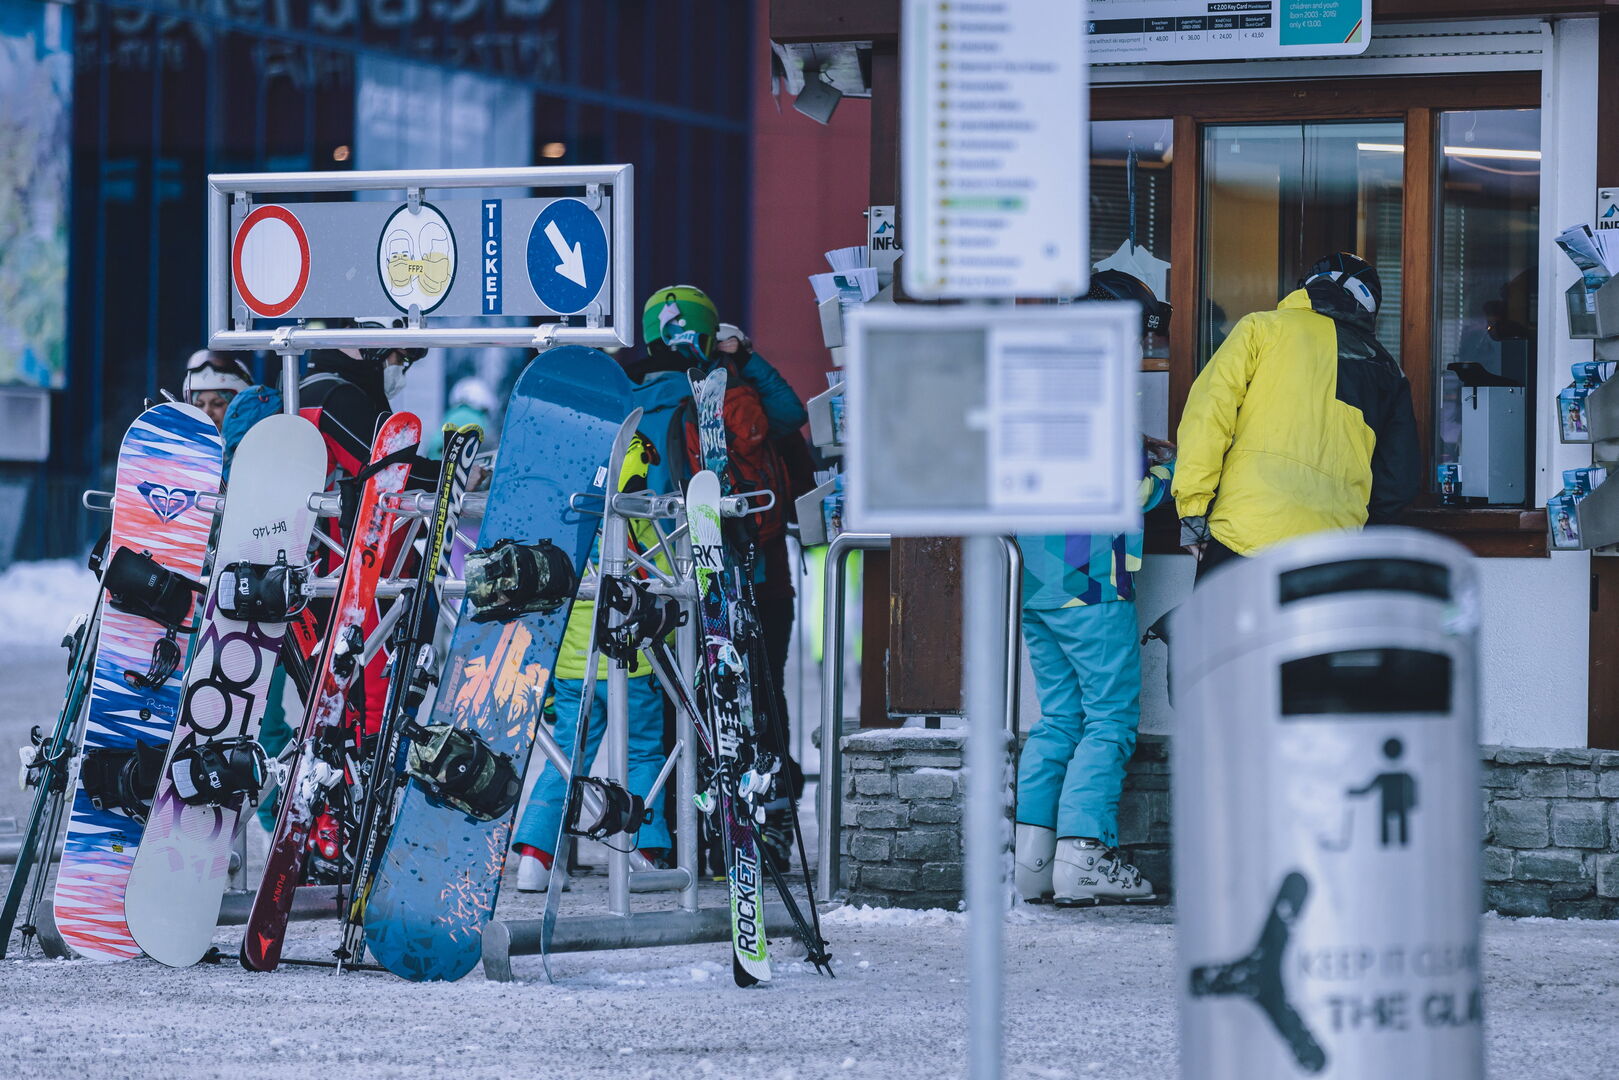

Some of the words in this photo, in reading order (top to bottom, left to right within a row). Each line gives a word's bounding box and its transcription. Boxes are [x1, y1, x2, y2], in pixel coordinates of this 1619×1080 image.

[408, 264, 424, 272] FFP2
[486, 204, 498, 310] TICKET
[448, 444, 462, 462] SX
[252, 526, 270, 540] 146
[272, 521, 287, 534] BFF
[428, 462, 456, 582] SUPERCROSS
[272, 873, 286, 903] PUNX
[735, 848, 758, 955] ROCKET
[1326, 991, 1408, 1031] THE
